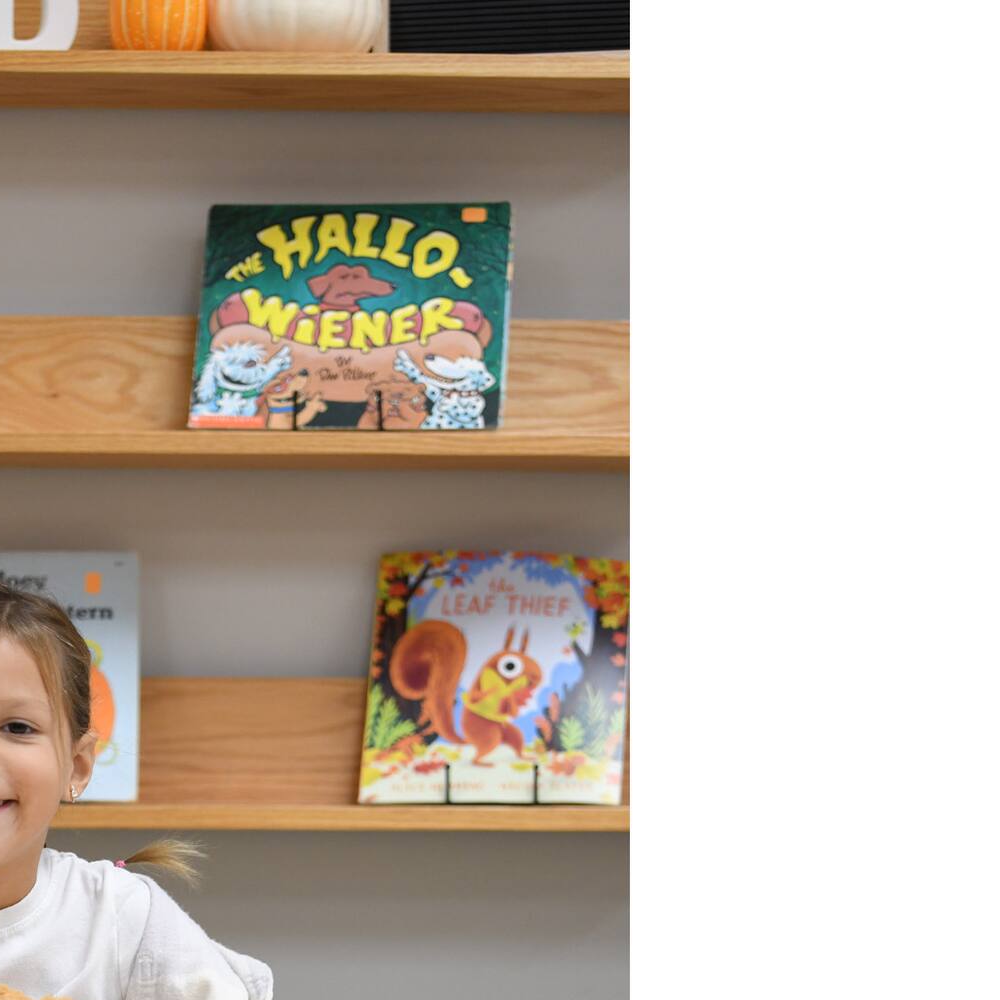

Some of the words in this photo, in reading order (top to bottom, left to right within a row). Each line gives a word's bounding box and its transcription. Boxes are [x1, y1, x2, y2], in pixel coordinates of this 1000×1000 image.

[225, 251, 266, 283] THE
[66, 604, 114, 620] tern
[440, 592, 497, 617] LEAF
[504, 593, 570, 618] THIEF
